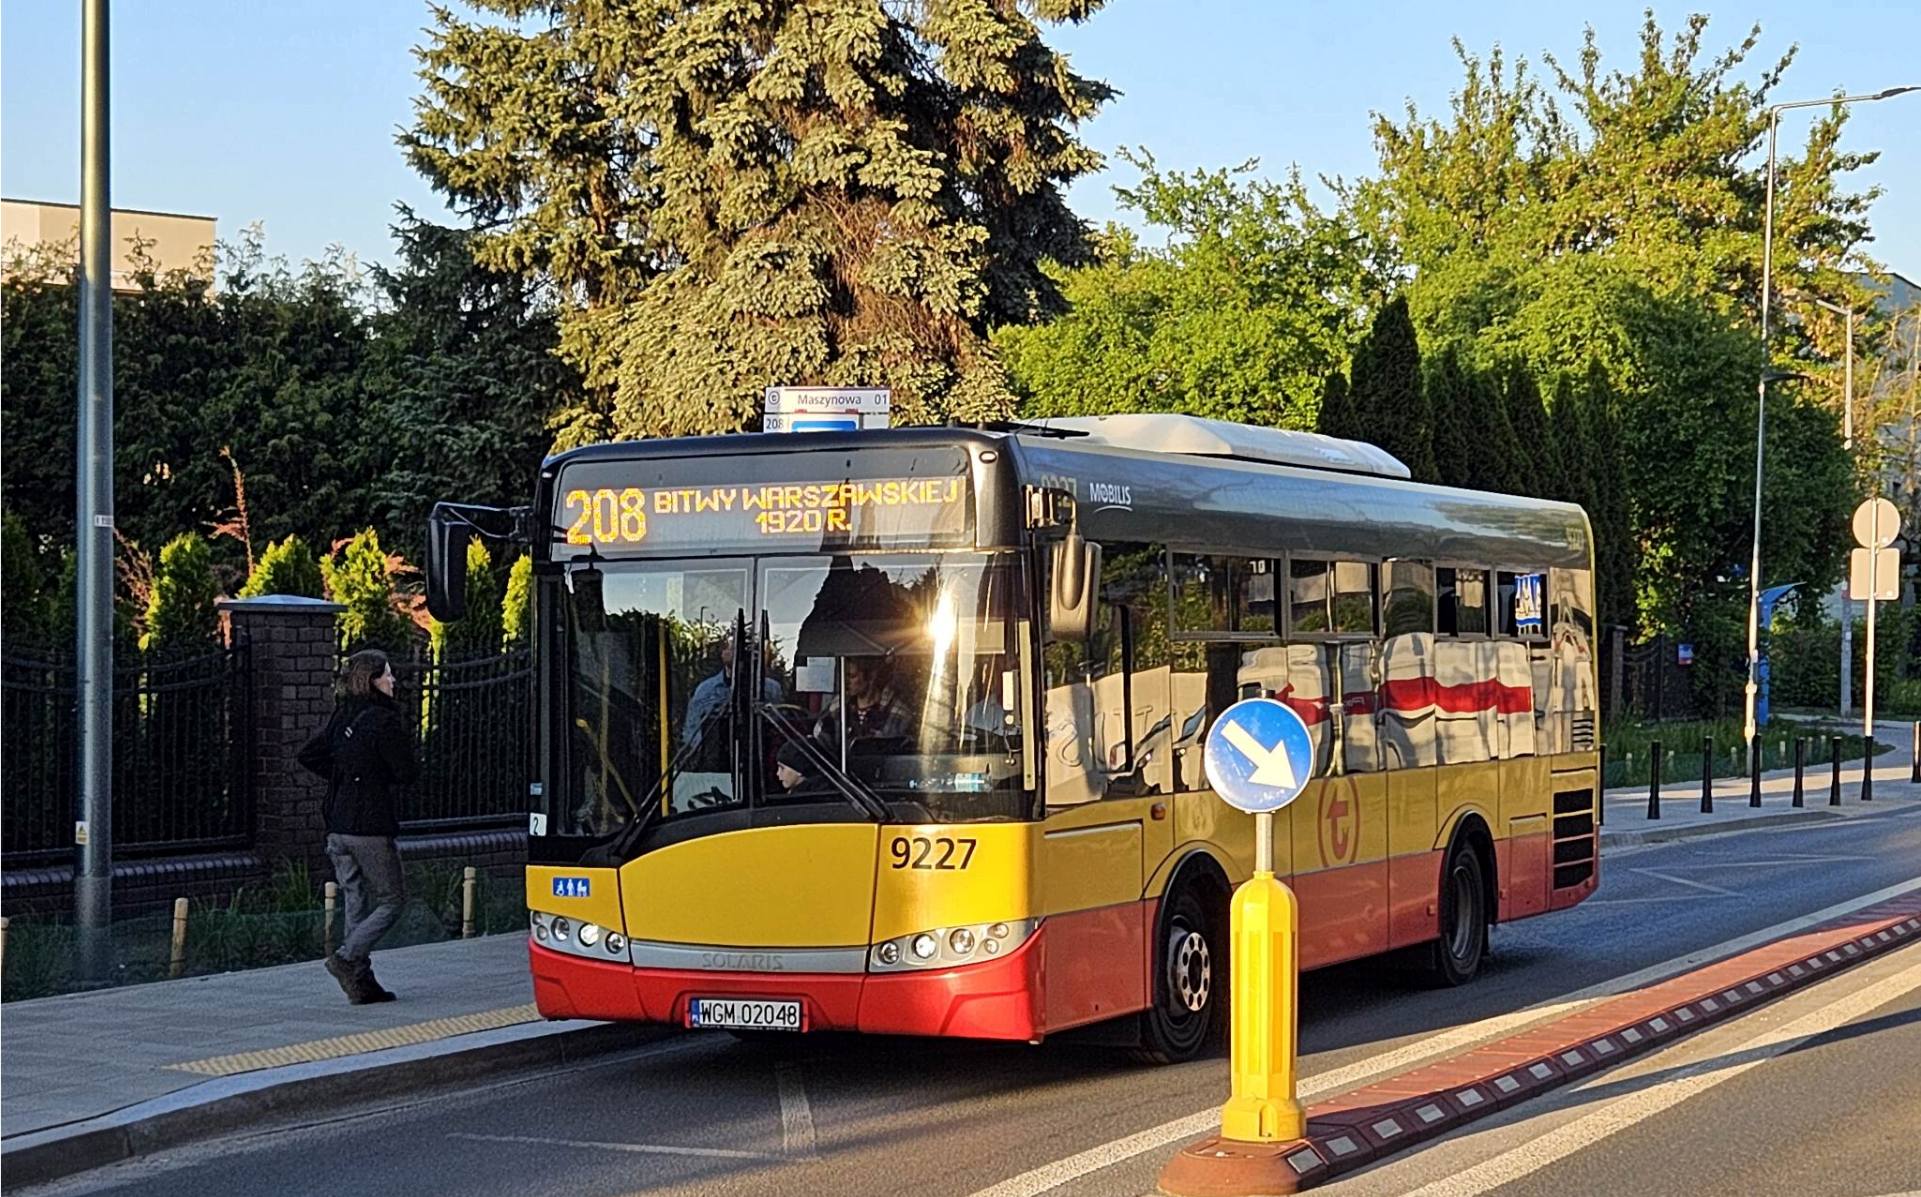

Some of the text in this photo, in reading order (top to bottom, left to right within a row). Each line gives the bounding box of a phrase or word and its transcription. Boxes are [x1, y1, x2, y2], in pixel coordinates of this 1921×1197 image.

[797, 394, 887, 408] Maszynowa 01
[766, 418, 784, 430] 208
[654, 479, 958, 513] BITWY WARSZAWSKIEJ
[1089, 482, 1132, 505] MOBILIS
[566, 488, 646, 544] 208
[755, 509, 853, 534] 1920 R.
[891, 837, 977, 869] 9227
[702, 953, 783, 970] SOLARIS
[701, 1003, 797, 1025] WGM 02048
